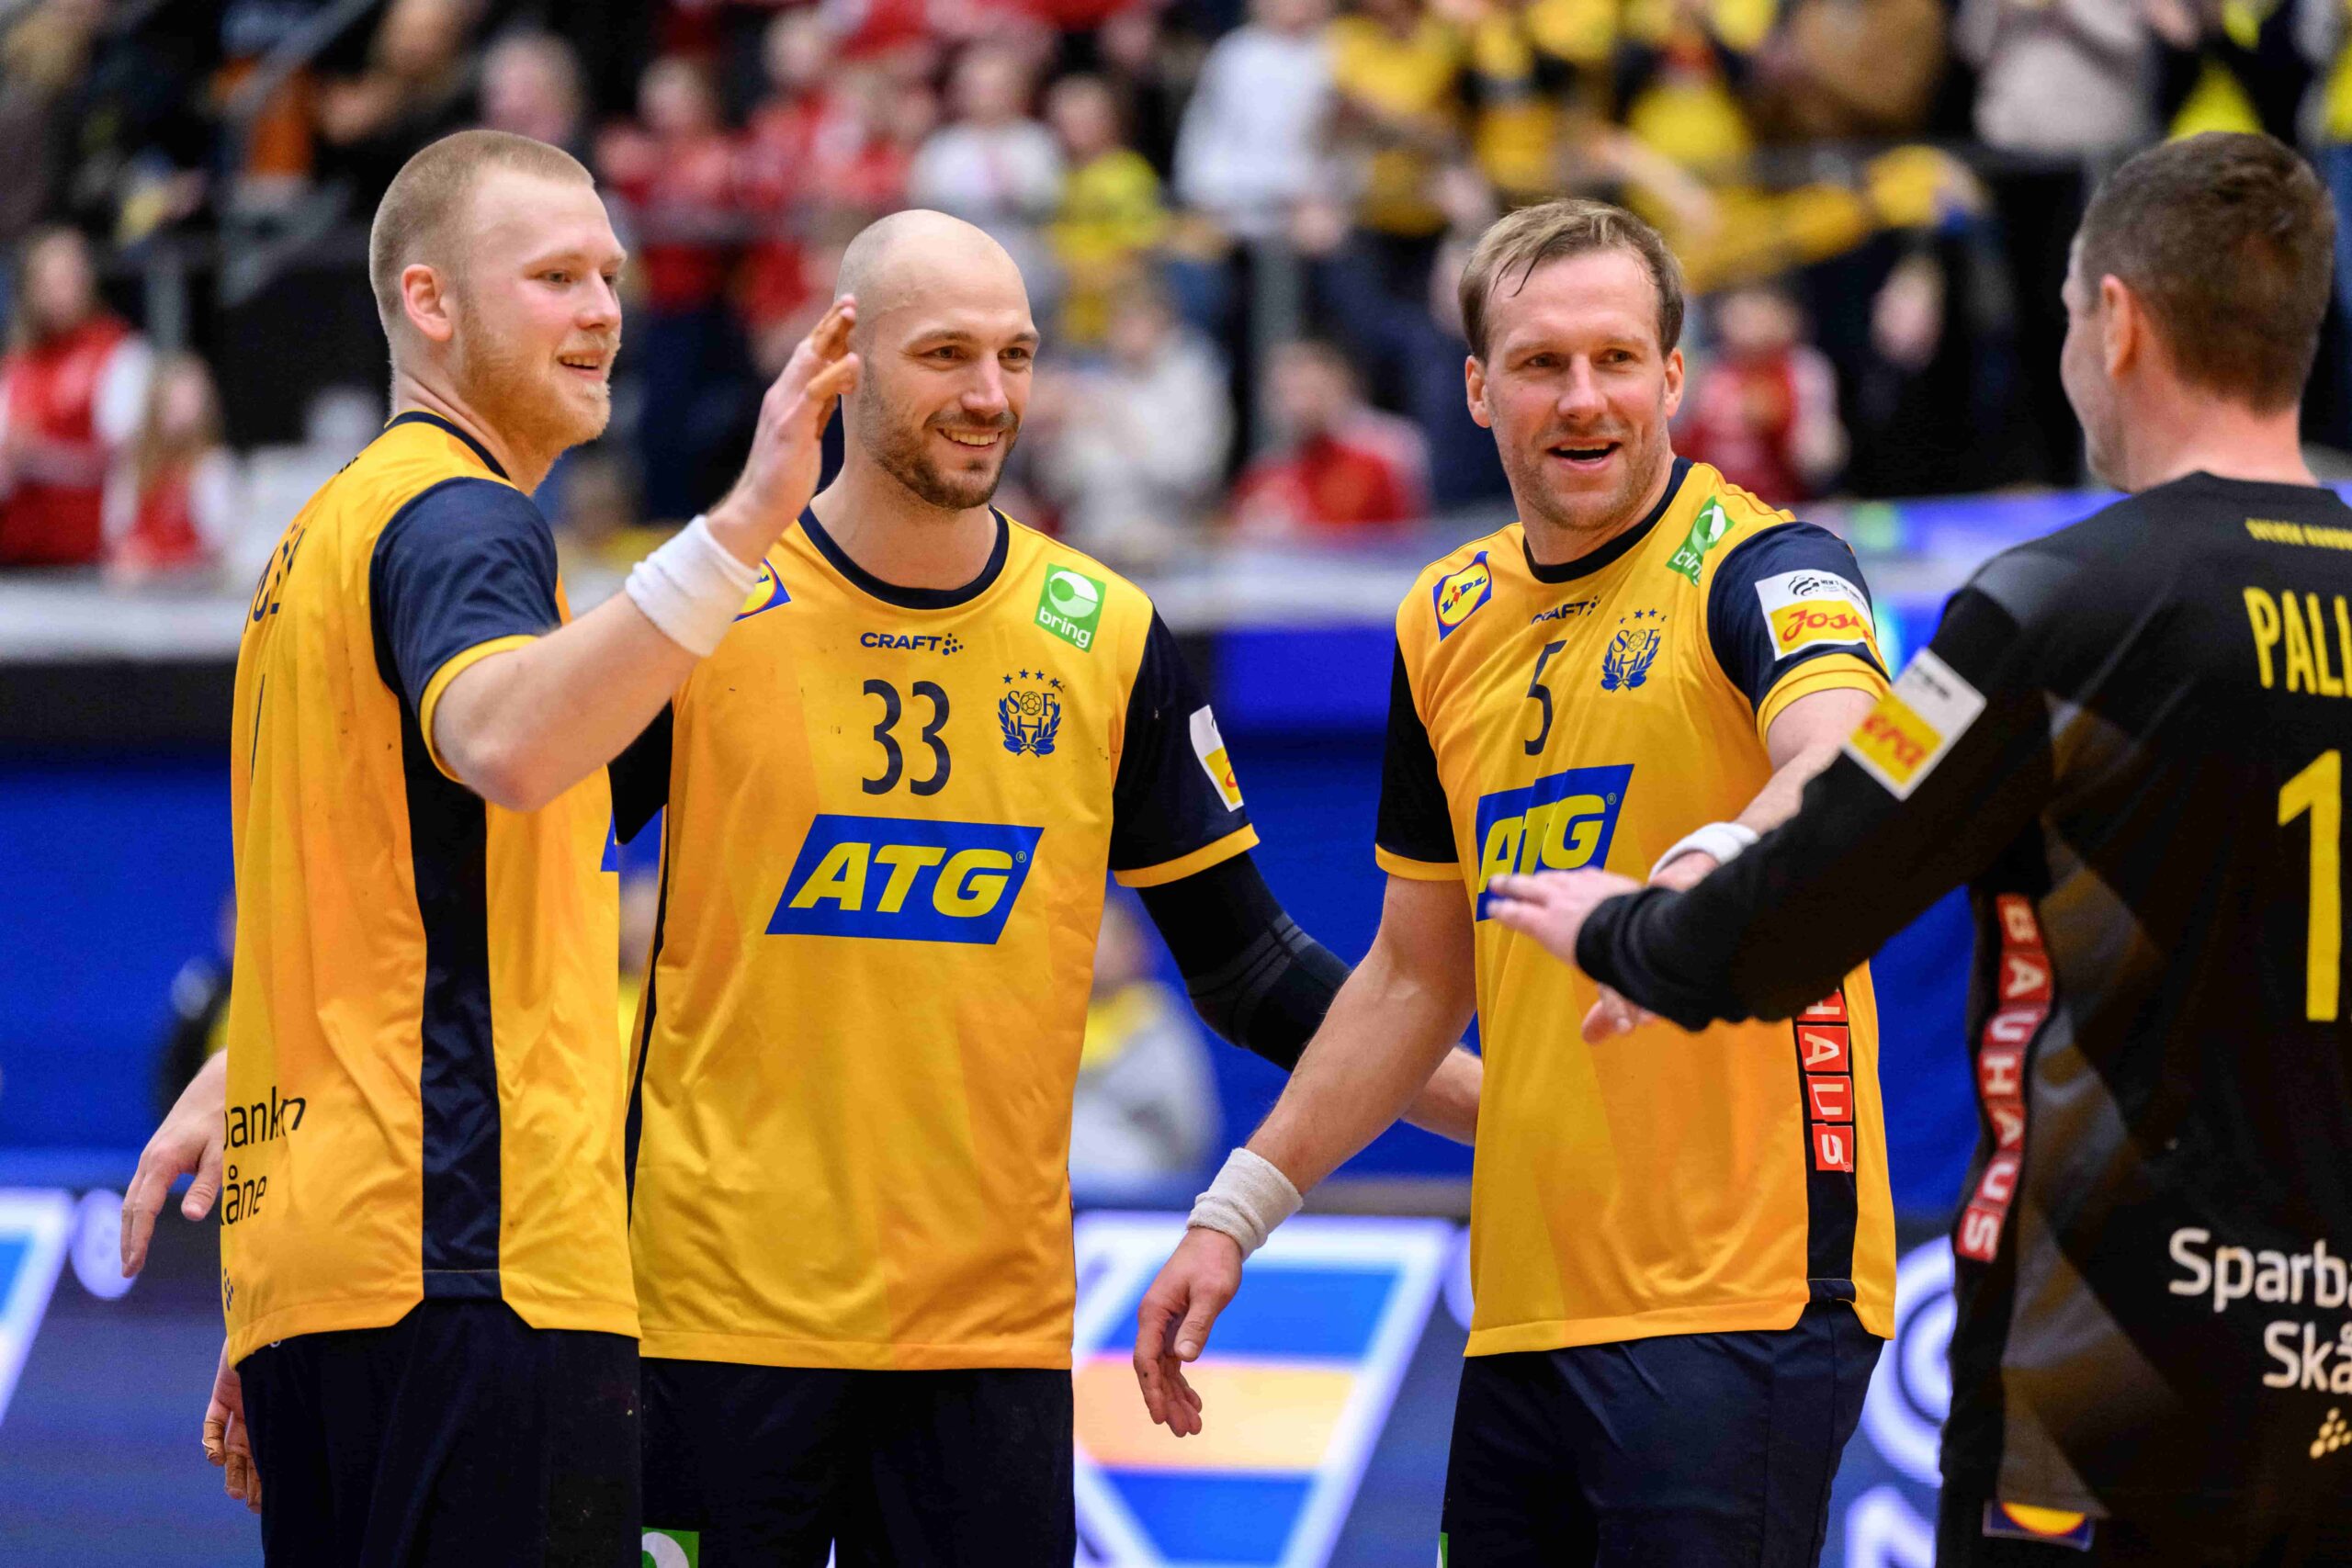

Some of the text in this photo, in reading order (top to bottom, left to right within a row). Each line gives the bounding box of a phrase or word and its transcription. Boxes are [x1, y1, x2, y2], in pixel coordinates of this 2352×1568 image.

[860, 632, 942, 652] CRAFT
[1039, 606, 1091, 649] bring
[1531, 601, 1589, 626] CAFT
[862, 679, 952, 796] 33
[1525, 639, 1567, 755] 5
[787, 841, 1013, 918] ATG
[1477, 794, 1606, 894] ATG
[1964, 902, 2047, 1253] BAUHAUS
[2168, 1226, 2352, 1314] Sparb
